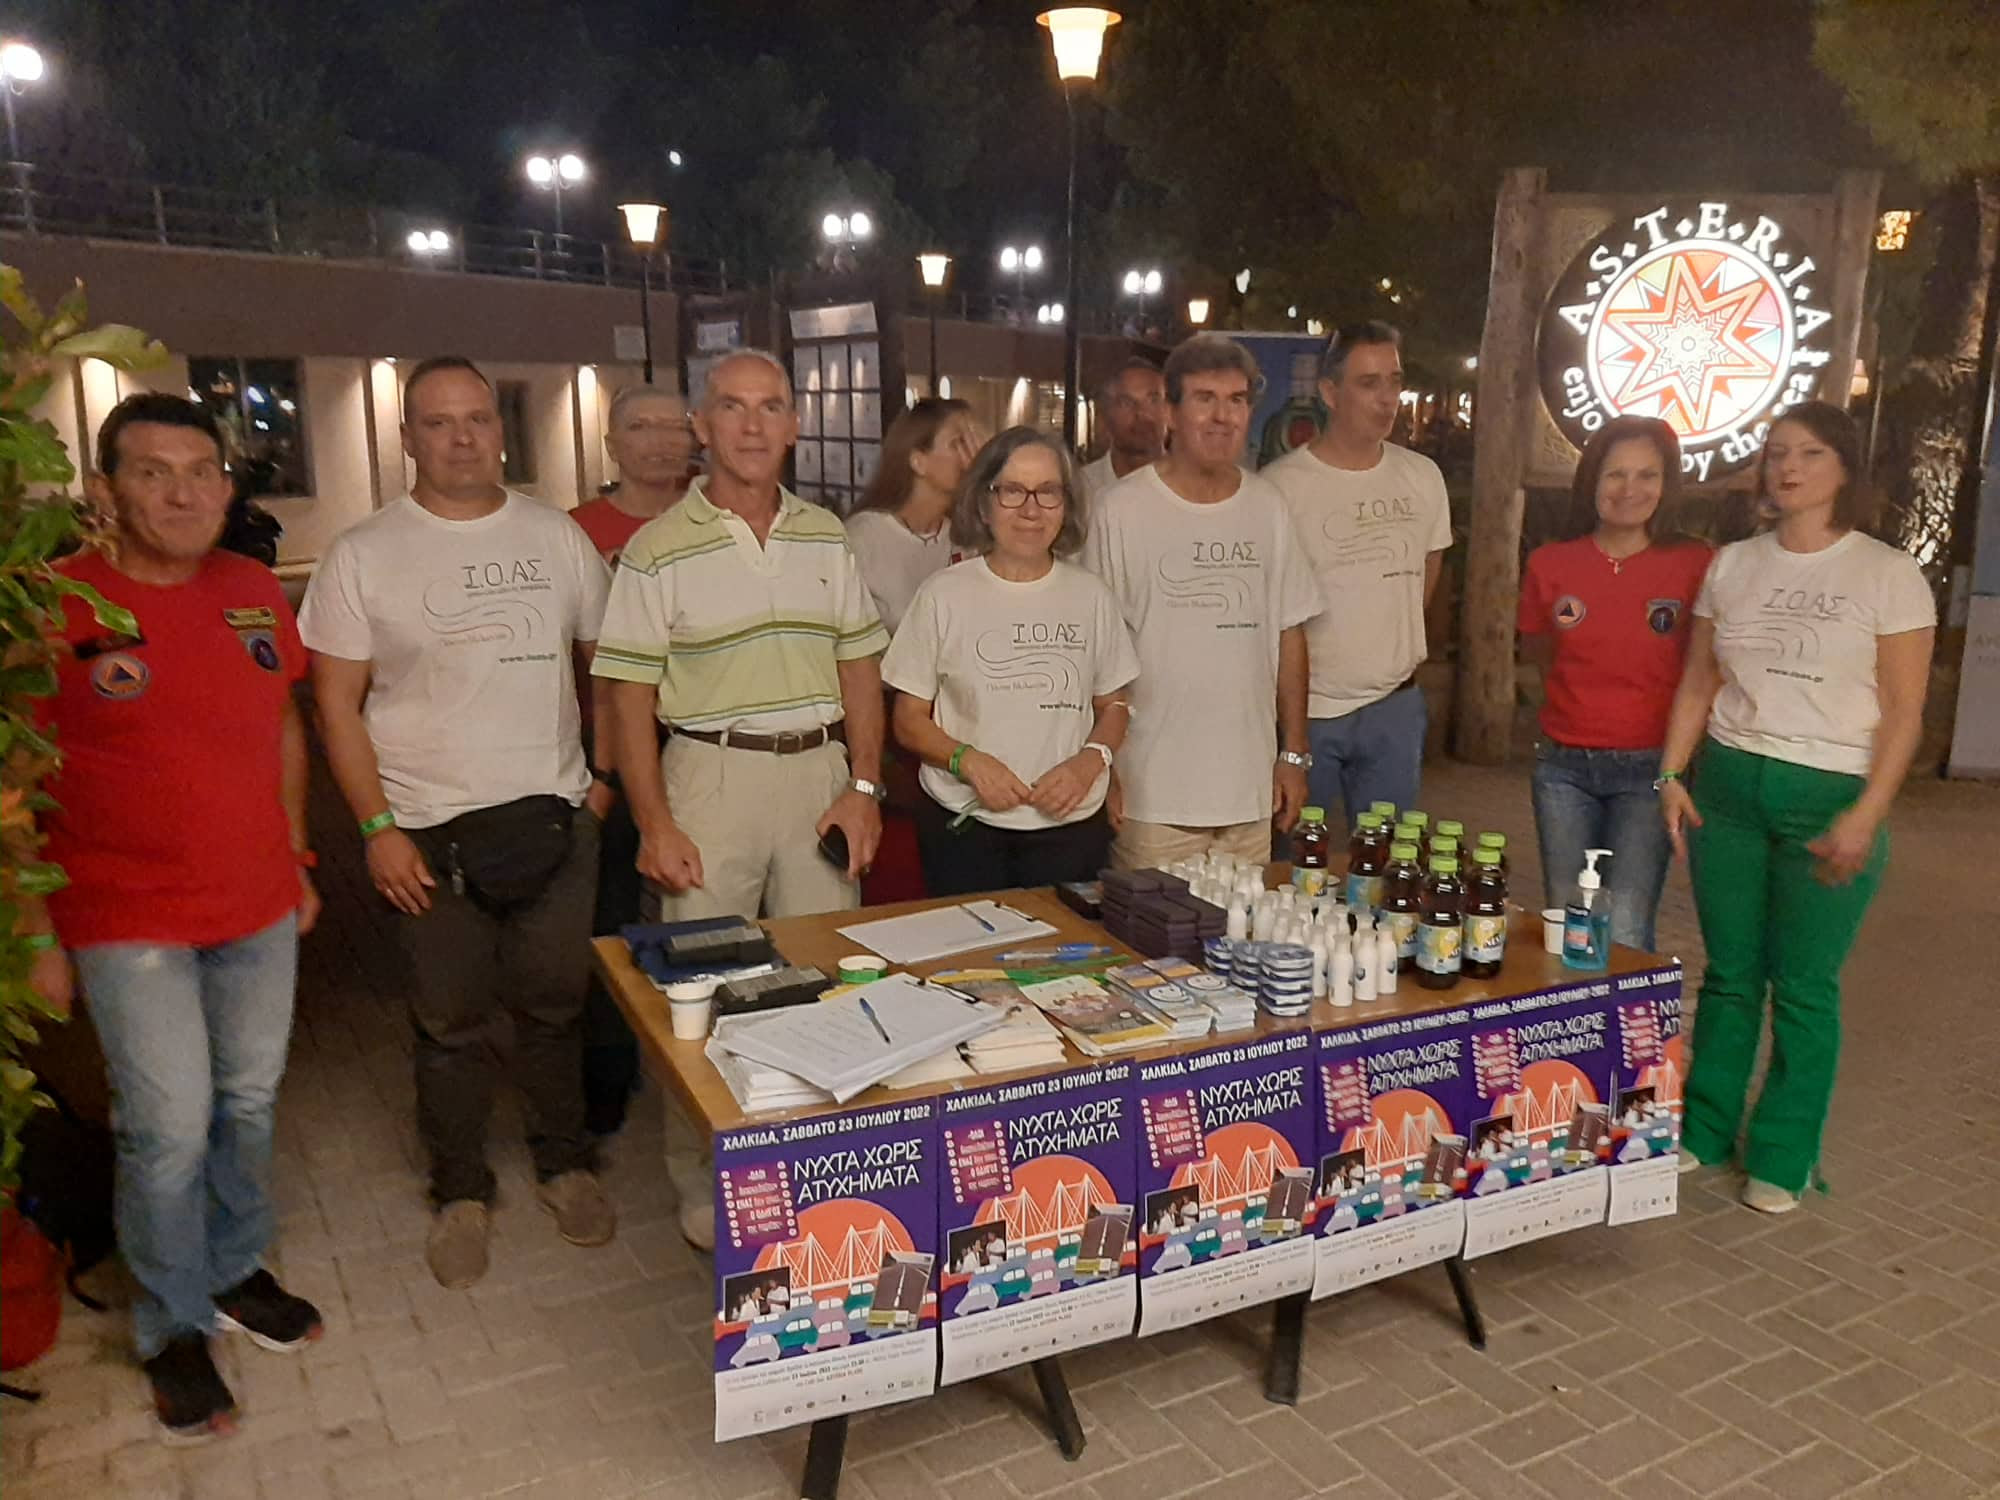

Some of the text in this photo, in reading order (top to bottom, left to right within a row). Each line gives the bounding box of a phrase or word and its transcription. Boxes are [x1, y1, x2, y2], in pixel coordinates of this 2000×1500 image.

[1563, 366, 1603, 432] enjo
[1517, 1020, 1563, 1044] ΝΥΧΤΑ
[1562, 1011, 1607, 1036] ΧΩΡΙΣ
[1188, 1051, 1231, 1071] ΣΑΒΒΑΤΟ
[1233, 1049, 1246, 1062] 23
[1247, 1041, 1284, 1059] ΙΟΥΛΙΟΥ
[1286, 1035, 1308, 1050] 2022
[1367, 1047, 1418, 1074] ΝΥΧΤΑ
[1416, 1038, 1463, 1063] ΧΩΡΙΣ
[1519, 1032, 1605, 1064] ΑΤΥΧΗΜΑΤΑ
[945, 1065, 1130, 1113] ΧΑΛΚΙΔΑ, ΣΑΒΒΑΤΟ 23 ΙΟΥΛΙΟΥ 2022
[1200, 1079, 1255, 1108] ΝΥΧΤΑ
[1256, 1067, 1304, 1095] ΧΩΡΙΣ
[1369, 1059, 1461, 1094] ΑΤΥΧΗΜΑΤΑ
[723, 1105, 931, 1152] ΧΑΛΚΙΔΑ, ΣΑΒΒΑΤΟ 23 ΙΟΥΛΙΟΥ 2022
[1009, 1110, 1068, 1140] ΝΥΧΤΑ
[1070, 1097, 1123, 1126] ΧΩΡΙΣ
[1204, 1089, 1303, 1129] ΑΤΥΧΗΜΑΤΑ
[794, 1150, 861, 1181] ΝΥΧΤΑ
[863, 1138, 923, 1169] ΧΩΡΙΣ
[1012, 1122, 1120, 1162] ΑΤΥΧΗΜΑΤΑ
[798, 1163, 921, 1205] ΑΤΥΧΗΜΑΤΑ
